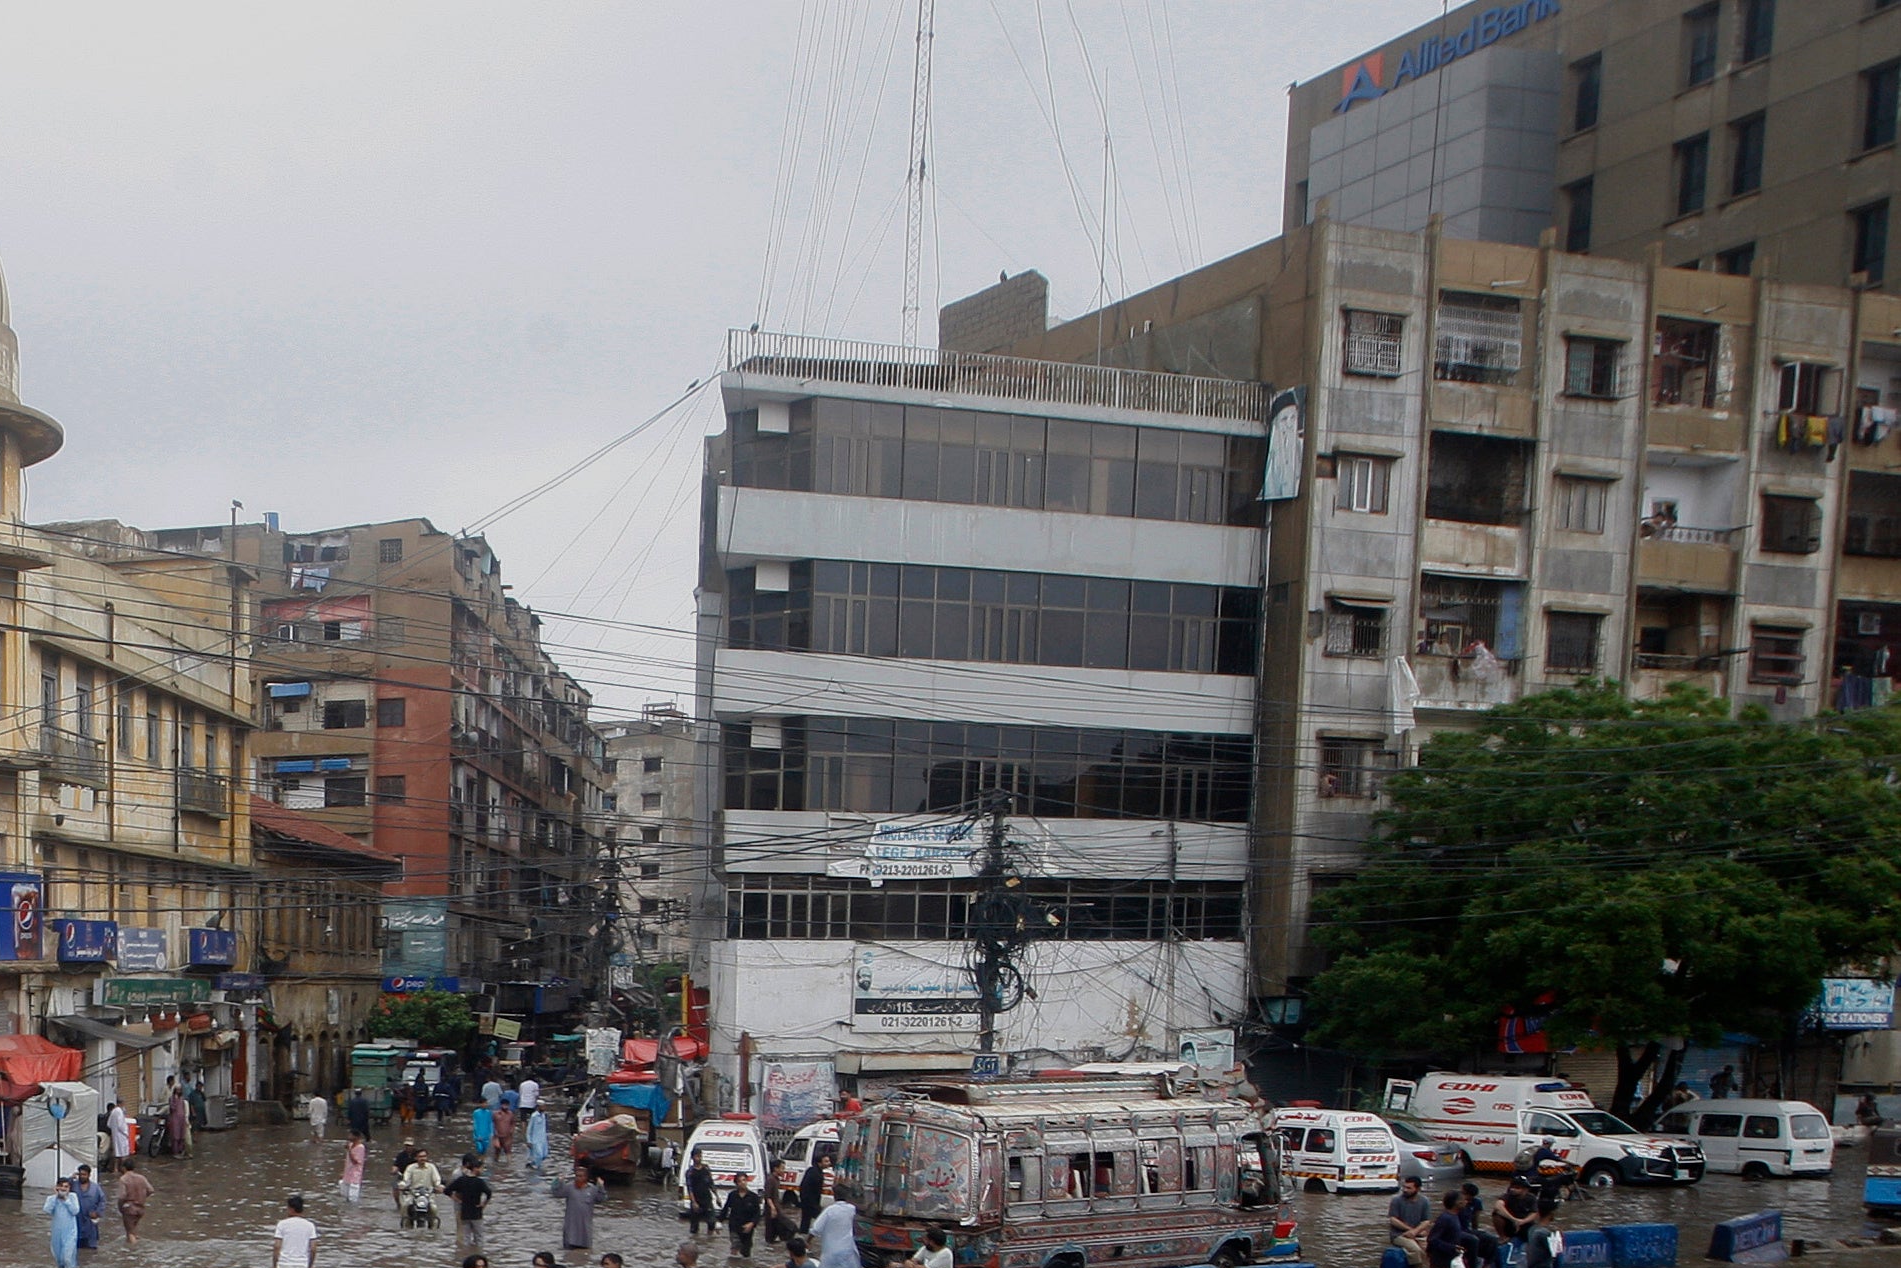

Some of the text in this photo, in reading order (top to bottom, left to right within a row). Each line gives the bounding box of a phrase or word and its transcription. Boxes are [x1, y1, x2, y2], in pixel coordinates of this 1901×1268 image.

[1394, 17, 1476, 89] Allied
[897, 1002, 912, 1013] 115
[881, 1017, 962, 1027] 021-32201261-2
[1438, 1082, 1499, 1092] EDHI
[704, 1130, 745, 1138] EDHI
